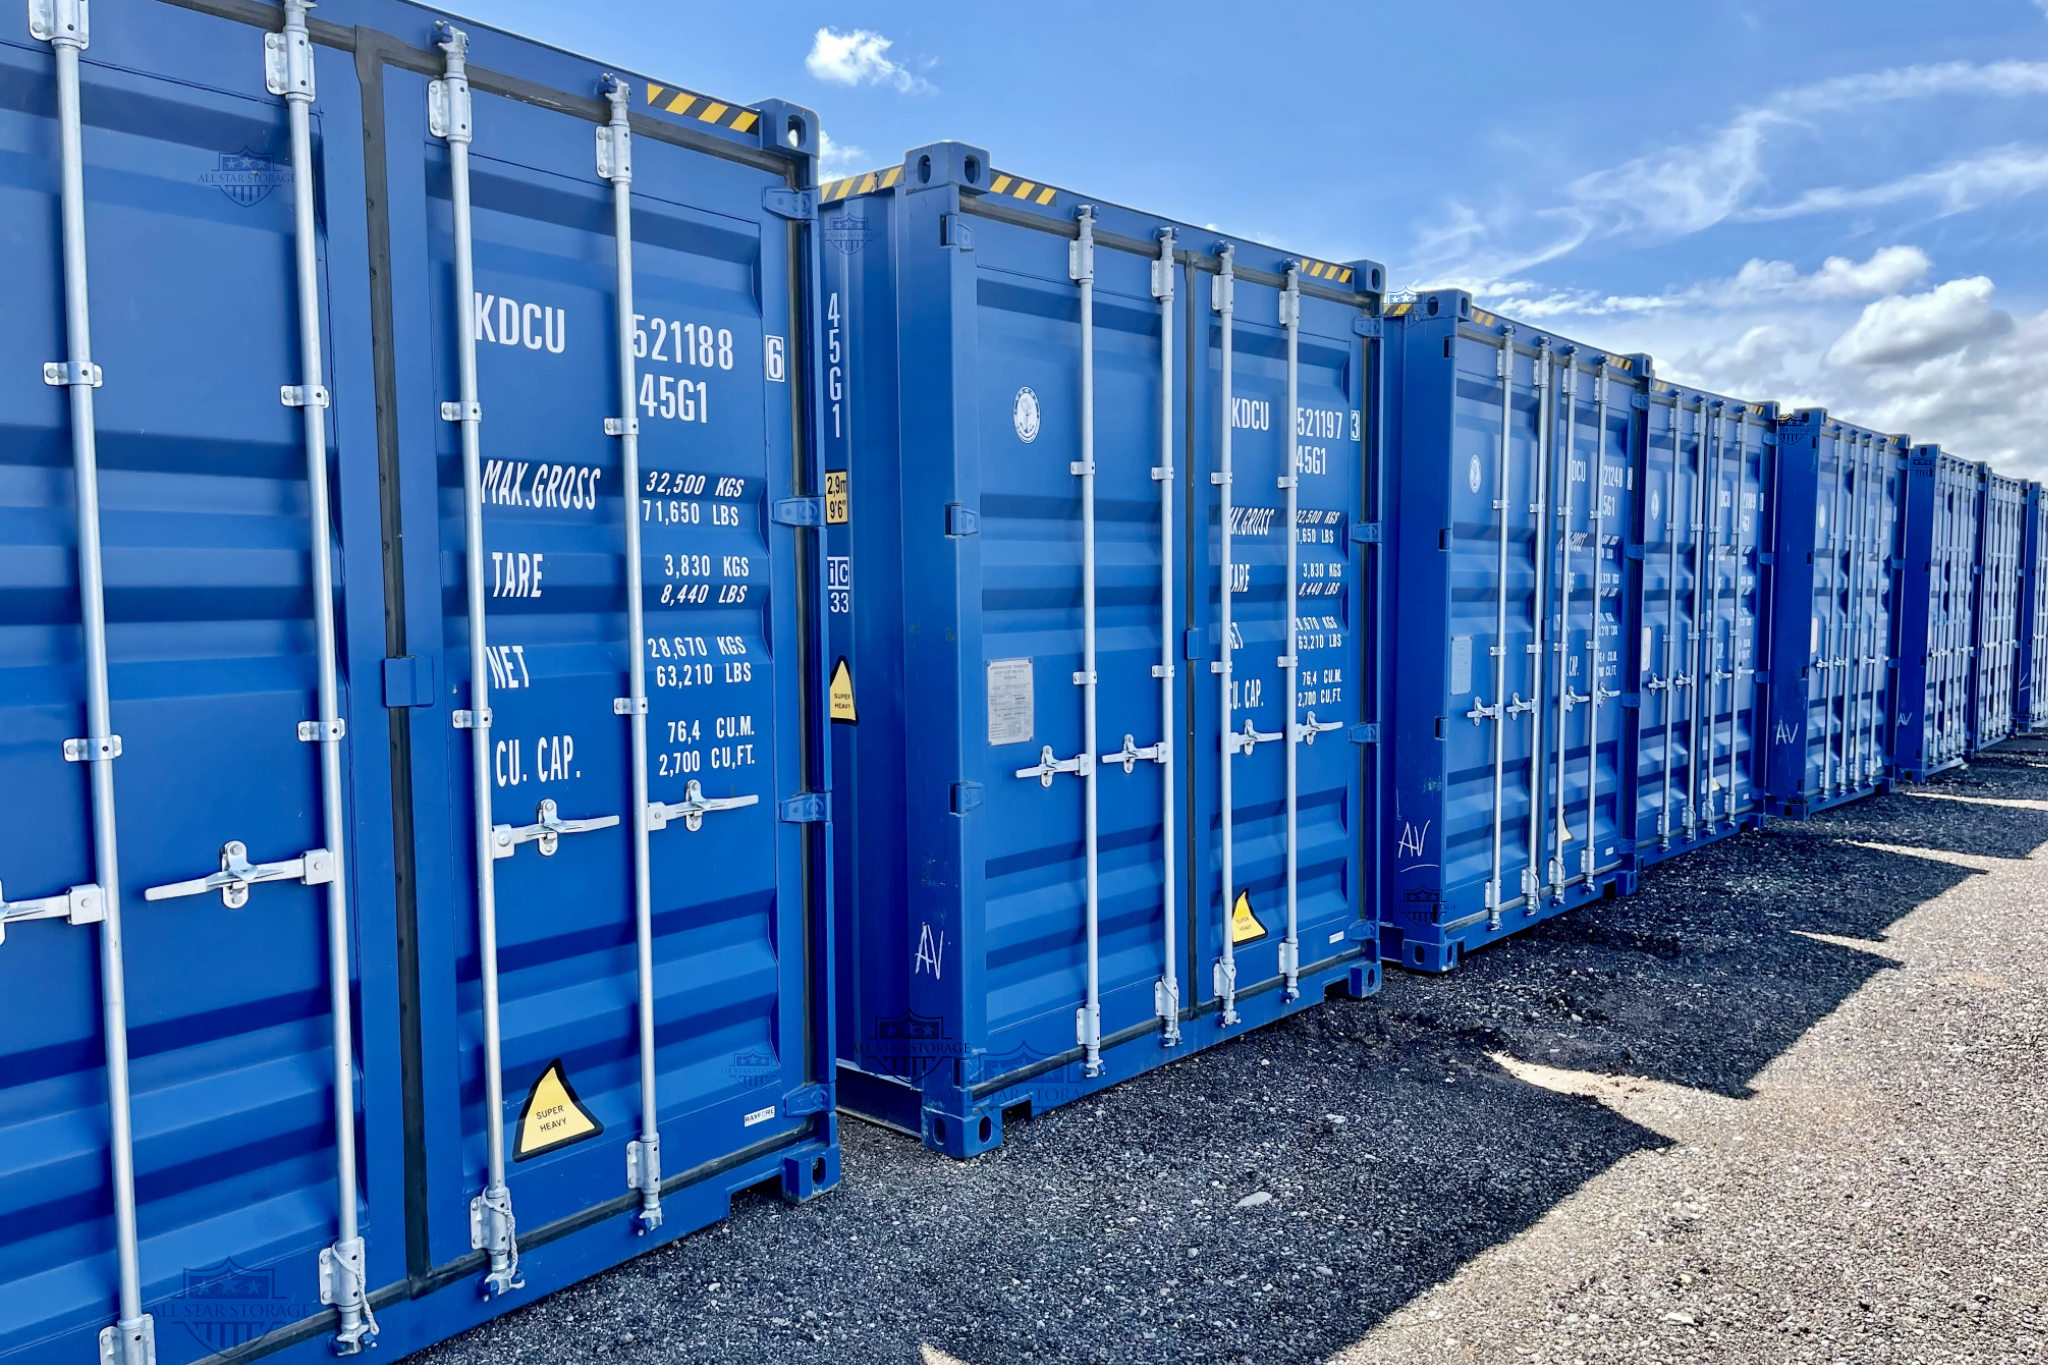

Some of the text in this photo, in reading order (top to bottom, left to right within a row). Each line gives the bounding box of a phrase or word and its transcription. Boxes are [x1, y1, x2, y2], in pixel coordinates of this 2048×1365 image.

[473, 291, 784, 381] KDCU 521188 6
[828, 292, 842, 438] 45G1
[639, 373, 708, 424] 45G1
[1231, 397, 1360, 441] KDCU 521197 3
[1296, 445, 1326, 476] 45G1
[1571, 459, 1586, 482] DCU
[1603, 465, 1625, 488] 21240
[481, 459, 745, 511] MAX.GROSS 32,500 KGS
[642, 500, 740, 527] 71,650 LBS
[1323, 511, 1341, 525] KGS
[1603, 495, 1616, 517] 5G1
[1296, 528, 1334, 545] 1,650 LBS
[492, 551, 750, 598] TARE 3,830 KGS
[1303, 562, 1325, 579] 3,830
[1328, 563, 1342, 578] KGS
[660, 583, 748, 607] 8,440 LBS
[829, 591, 850, 613] 33
[1298, 582, 1341, 597] 8,440 LBS
[1230, 616, 1339, 650] ET 8,670 KGS
[1297, 633, 1343, 652] 63,210 LBS
[485, 635, 747, 690] NET 28,670 KGS
[656, 661, 752, 690] 63,210 LBS
[1244, 678, 1264, 710] CAP.
[1302, 670, 1318, 687] 76,4
[1297, 690, 1318, 709] 2,700
[1775, 719, 1799, 746] AV
[495, 715, 756, 788] CU. CAP. 76,4 CU.M.
[659, 750, 701, 778] 2,700
[1397, 819, 1431, 859] AV
[914, 921, 944, 980] AV
[536, 1104, 565, 1121] SUPER
[540, 1116, 567, 1133] HEAVY
